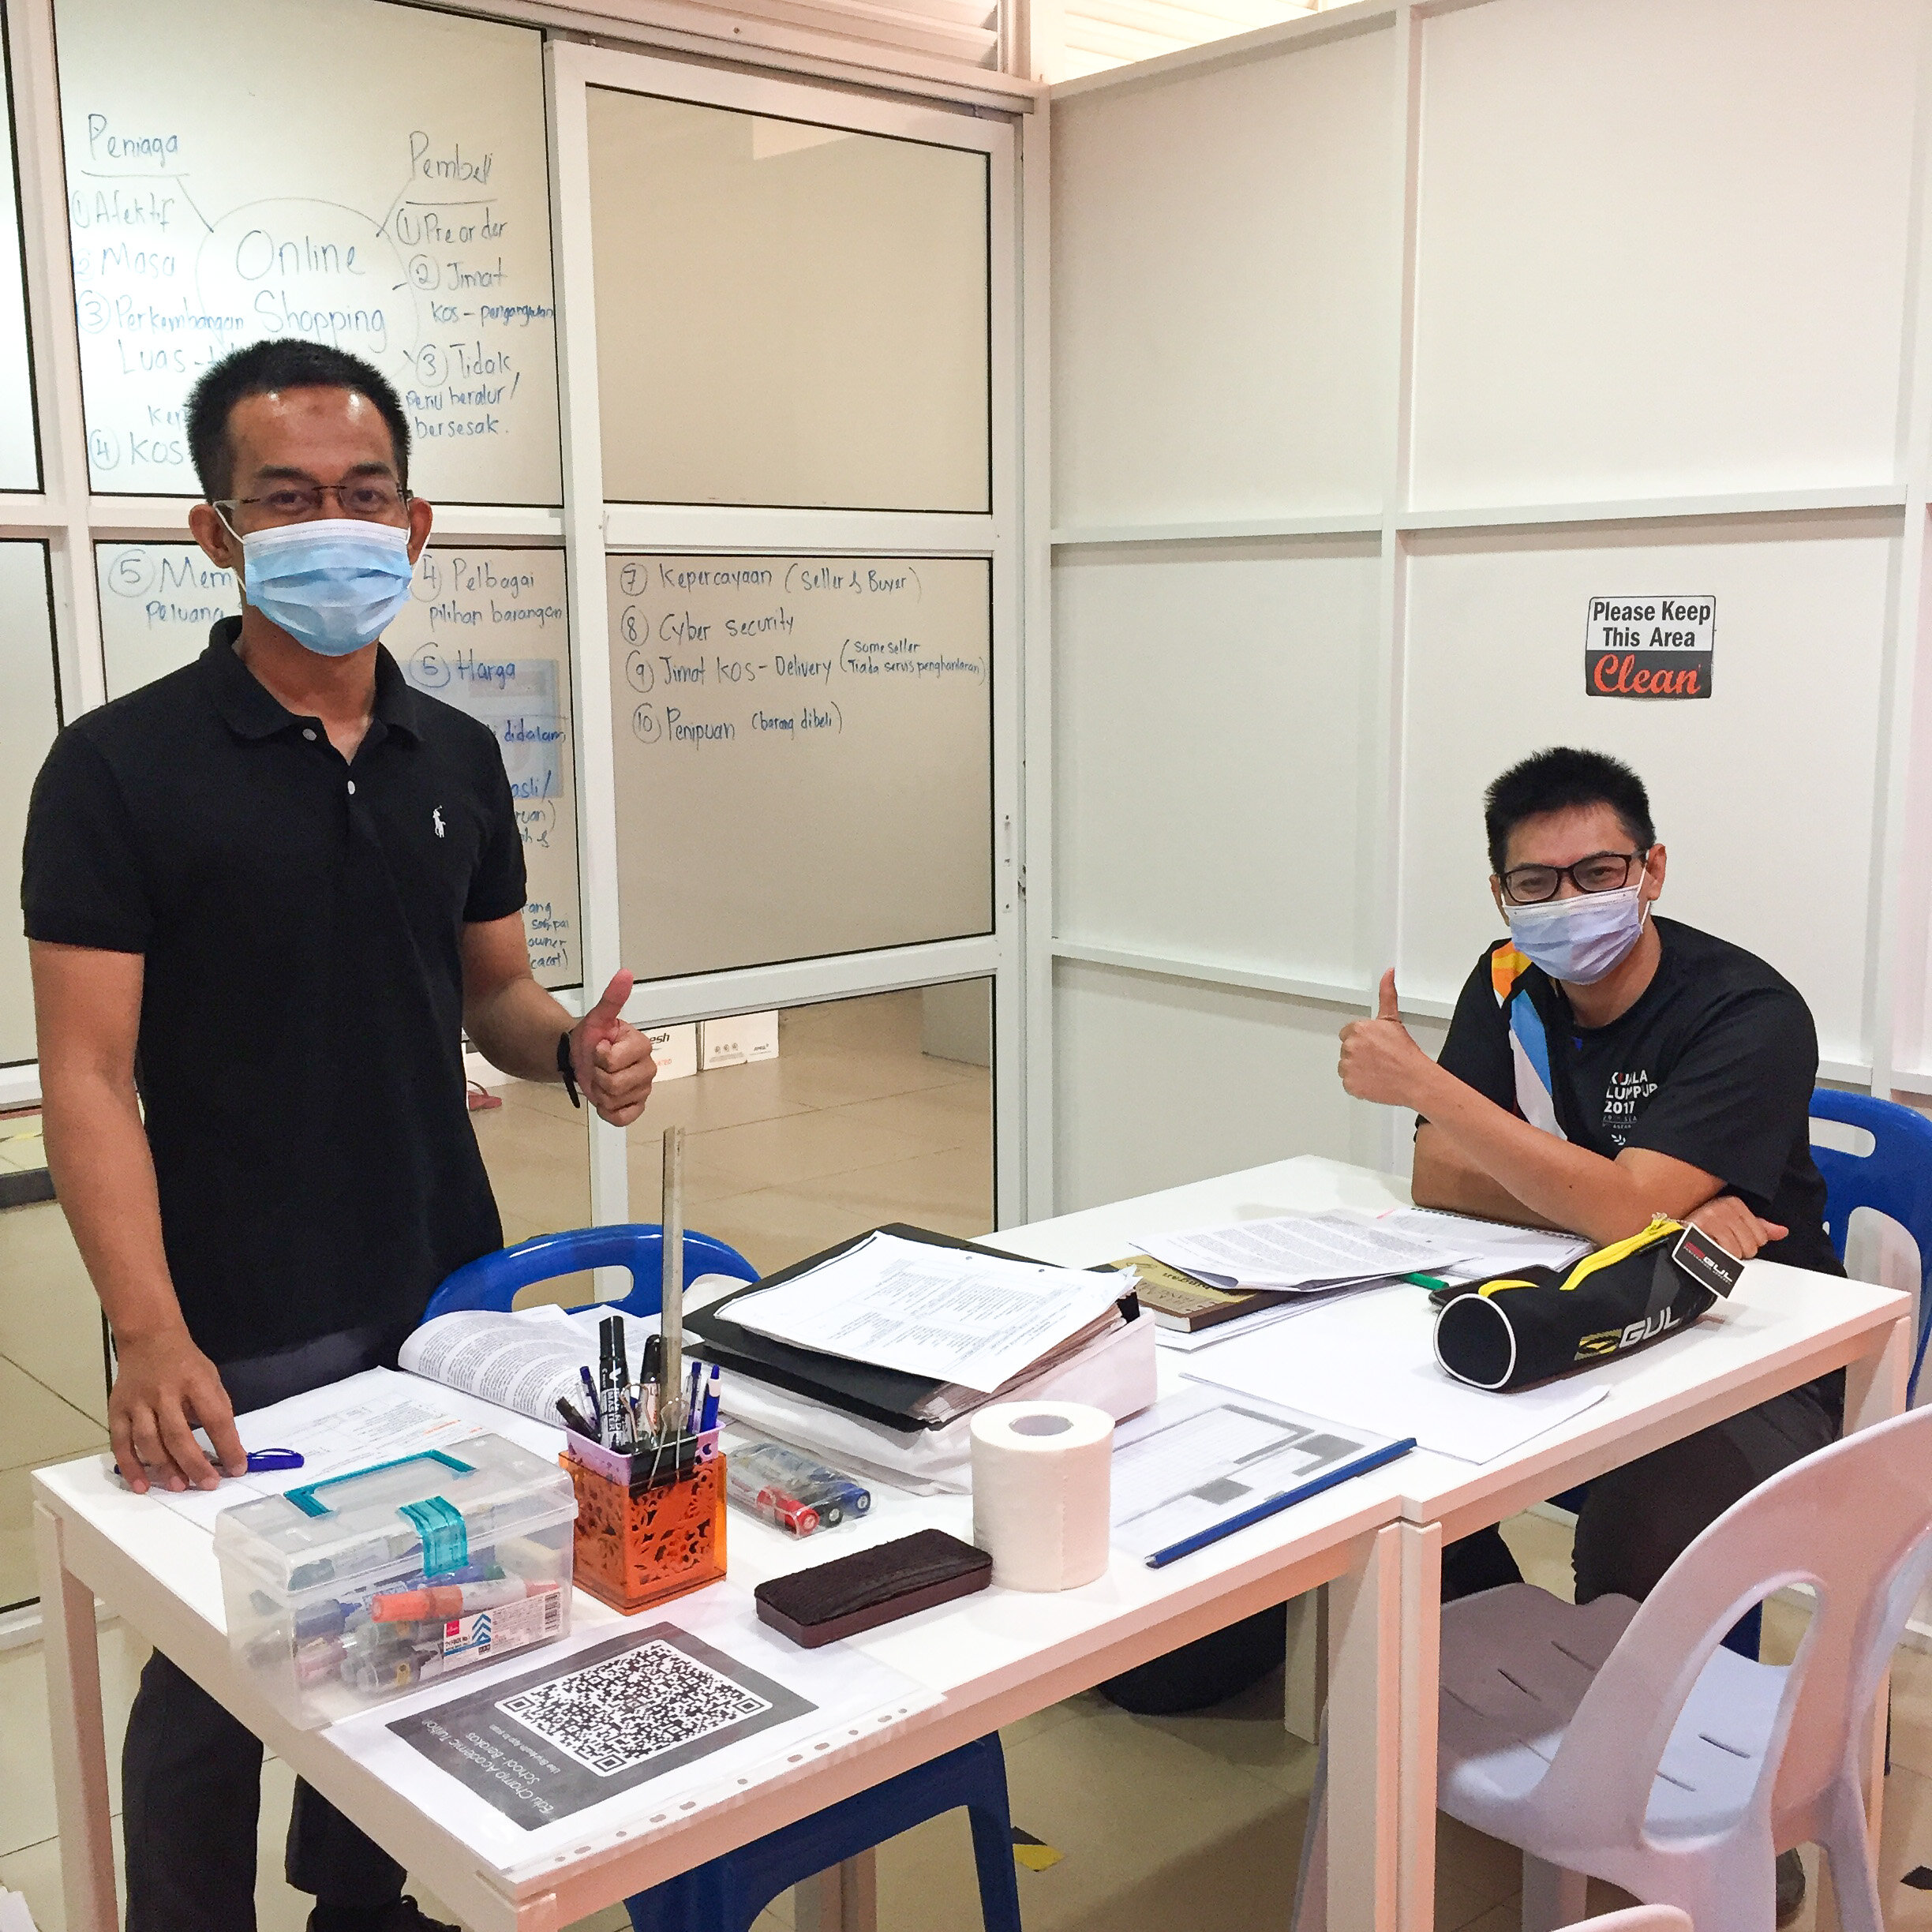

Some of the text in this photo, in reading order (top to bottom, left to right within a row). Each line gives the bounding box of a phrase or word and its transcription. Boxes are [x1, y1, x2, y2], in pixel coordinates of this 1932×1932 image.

[88, 113, 178, 168] Peniaga
[101, 242, 175, 279] Masa
[236, 230, 366, 281] Online
[254, 290, 388, 354] Shopping
[450, 341, 511, 379] Tidak
[452, 557, 534, 599] Pelbagai
[659, 563, 773, 593] Kepercayaan
[659, 611, 711, 646] Cyber
[724, 606, 794, 635] security
[1593, 601, 1711, 625] Please Keep
[1603, 627, 1695, 647] This Area
[458, 648, 516, 690] Harga
[658, 655, 706, 685] Jimat
[775, 654, 832, 686] Delivery
[1593, 653, 1702, 695] Clean
[666, 706, 736, 751] Penipuan
[1604, 1100, 1635, 1114] 2017
[1619, 1305, 1681, 1348] GUL
[448, 1739, 500, 1773] Academic
[501, 1758, 540, 1785] School
[495, 1771, 534, 1799] Champ
[530, 1796, 554, 1814] Edu
